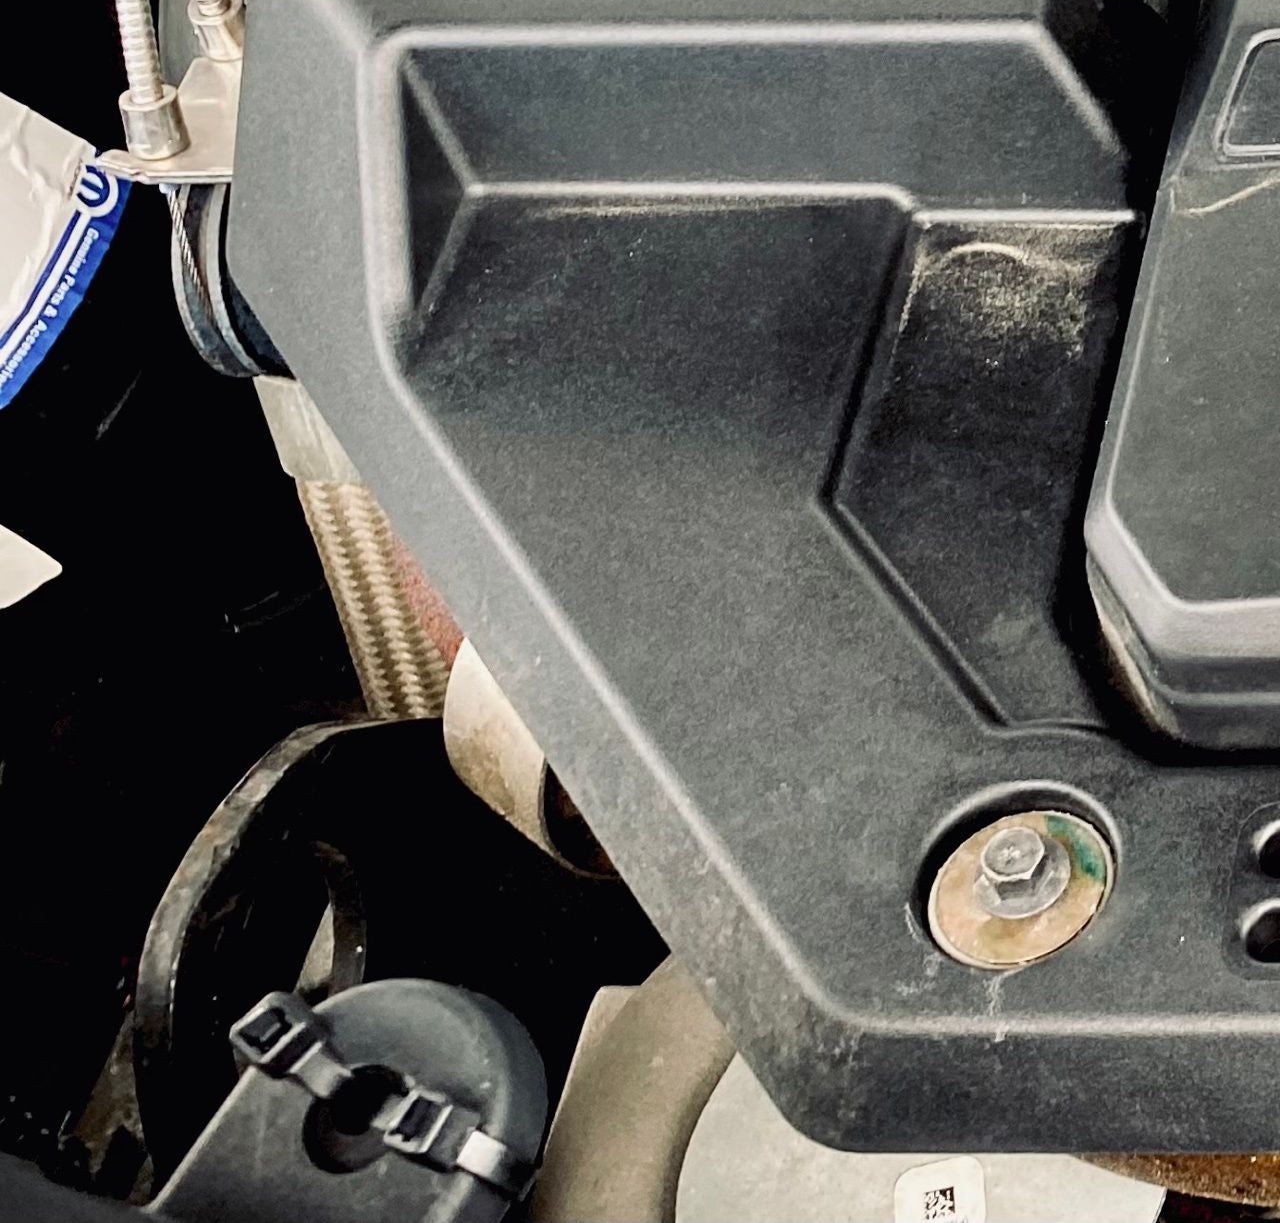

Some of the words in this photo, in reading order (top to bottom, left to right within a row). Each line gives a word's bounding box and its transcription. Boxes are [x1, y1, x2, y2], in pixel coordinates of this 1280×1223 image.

[67, 226, 100, 275] Genuine
[50, 275, 76, 305] Parts
[44, 305, 60, 319] &
[0, 319, 48, 390] Accessorie
